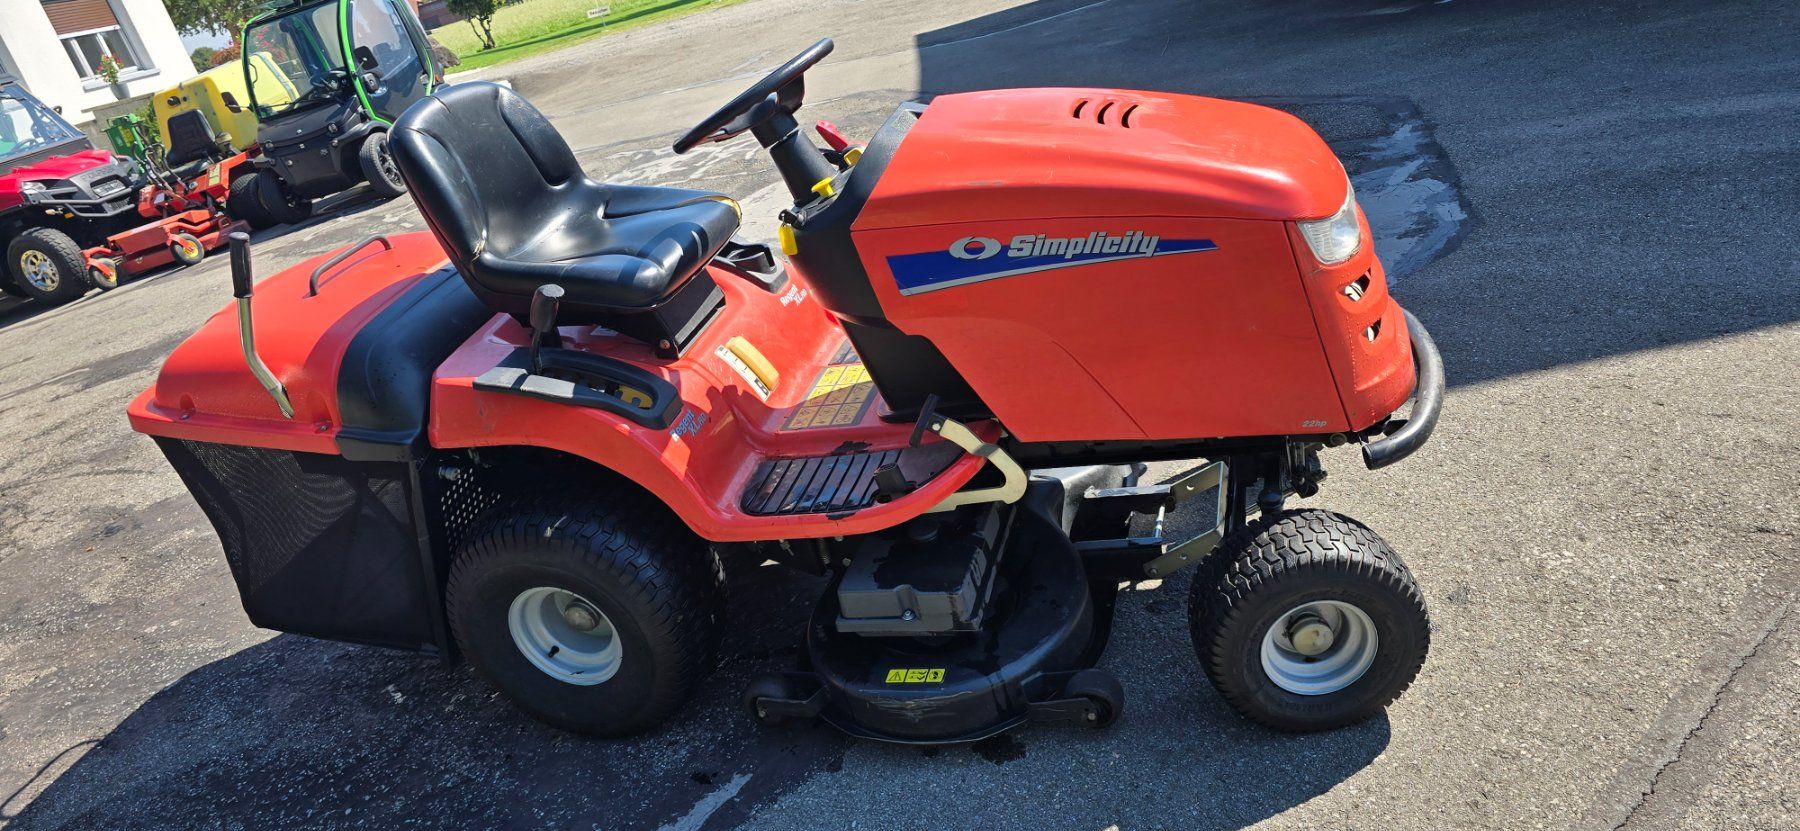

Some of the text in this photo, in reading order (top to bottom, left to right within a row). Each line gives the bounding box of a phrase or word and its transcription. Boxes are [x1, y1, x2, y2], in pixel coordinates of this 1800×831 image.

[1007, 231, 1159, 259] Simplicity
[780, 283, 798, 307] Regent
[669, 409, 695, 442] Regent
[1301, 420, 1327, 428] 22hp
